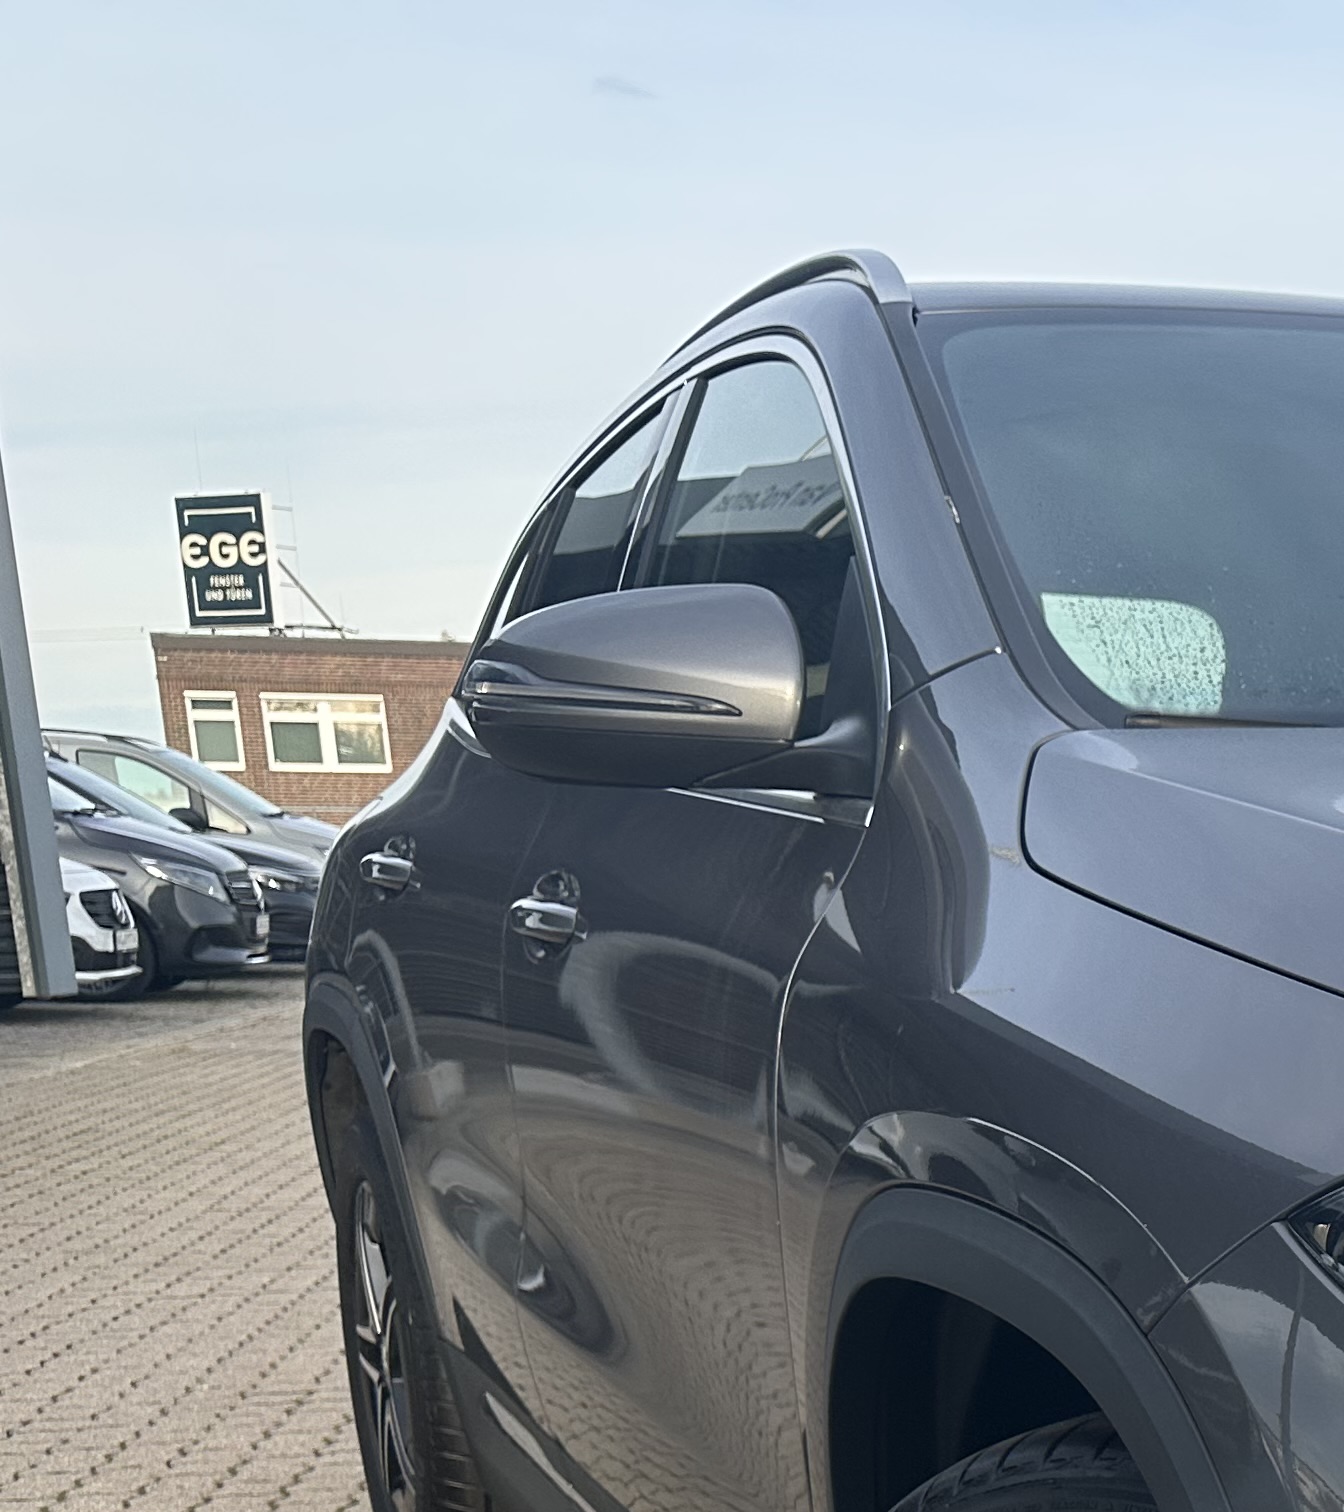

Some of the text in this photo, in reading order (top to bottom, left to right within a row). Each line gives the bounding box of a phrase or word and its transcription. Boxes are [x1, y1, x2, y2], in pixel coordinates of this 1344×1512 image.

[181, 531, 267, 569] EGE
[209, 574, 245, 588] FENSTER
[205, 589, 224, 602] UND
